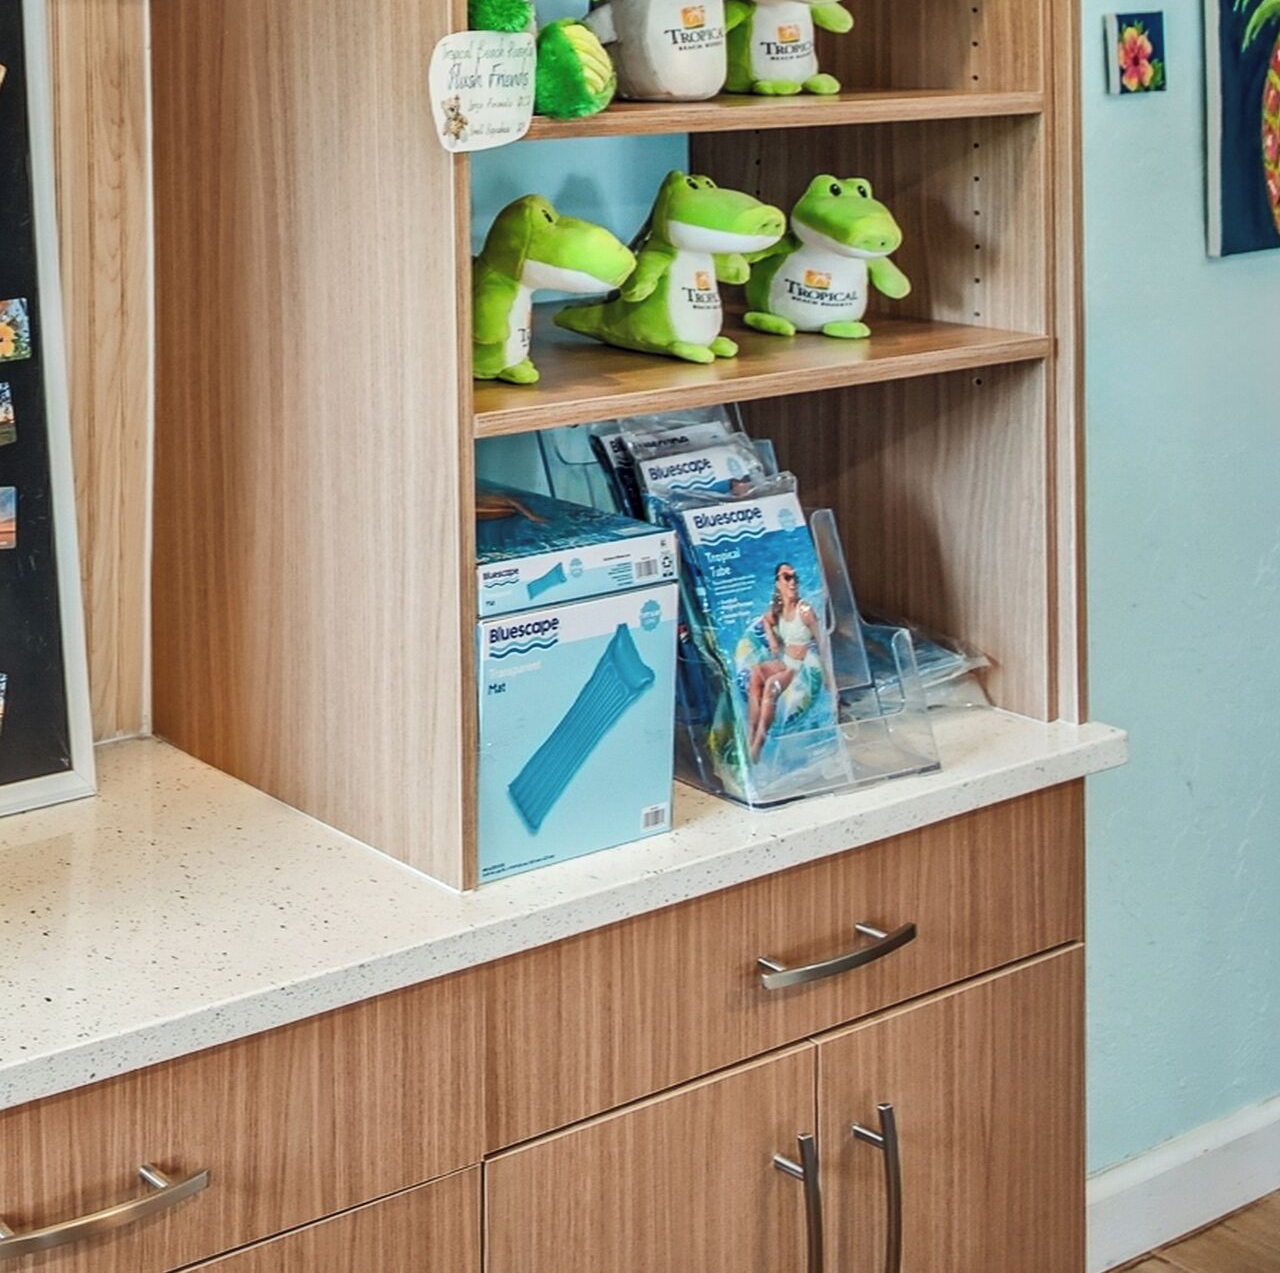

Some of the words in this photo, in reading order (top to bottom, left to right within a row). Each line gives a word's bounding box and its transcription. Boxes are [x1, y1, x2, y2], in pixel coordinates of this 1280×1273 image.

[784, 278, 859, 302] TROPICAL
[648, 456, 713, 481] Bluescape
[693, 505, 763, 530] Bluescape
[483, 566, 520, 581] Bluescape
[490, 617, 560, 644] Bluescape
[487, 682, 507, 695] Mat
